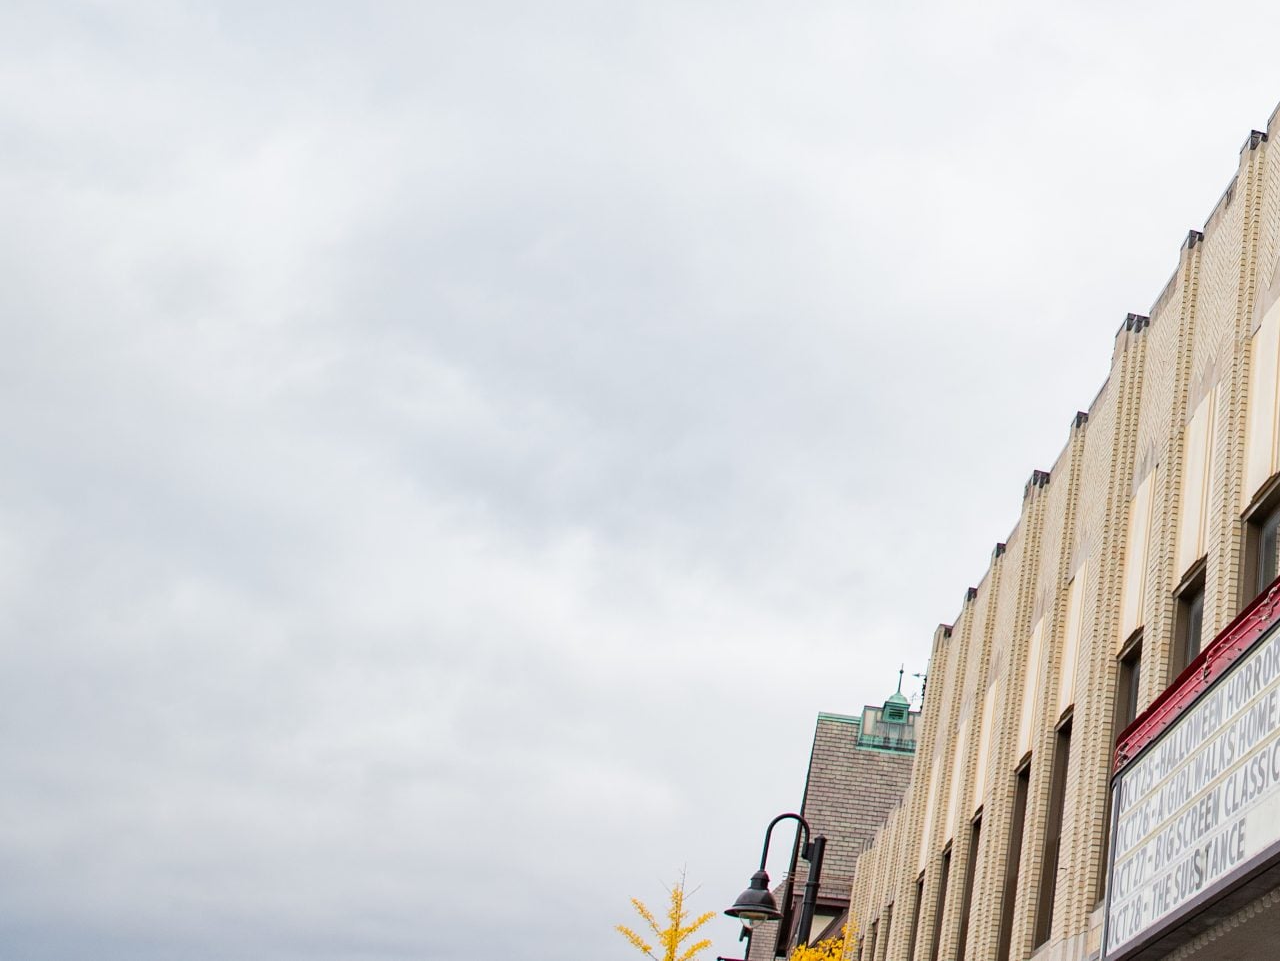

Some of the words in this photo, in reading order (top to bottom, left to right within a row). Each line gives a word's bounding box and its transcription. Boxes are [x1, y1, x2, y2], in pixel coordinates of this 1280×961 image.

[1156, 787, 1164, 825] A
[1167, 759, 1193, 817] GIRL
[1193, 721, 1236, 792] WALKS
[1237, 689, 1277, 756] HOME
[1151, 872, 1172, 921] THE
[1173, 816, 1247, 907] SUBSTANCE
[1154, 824, 1174, 872] BIG
[1175, 785, 1220, 861] SCREEN
